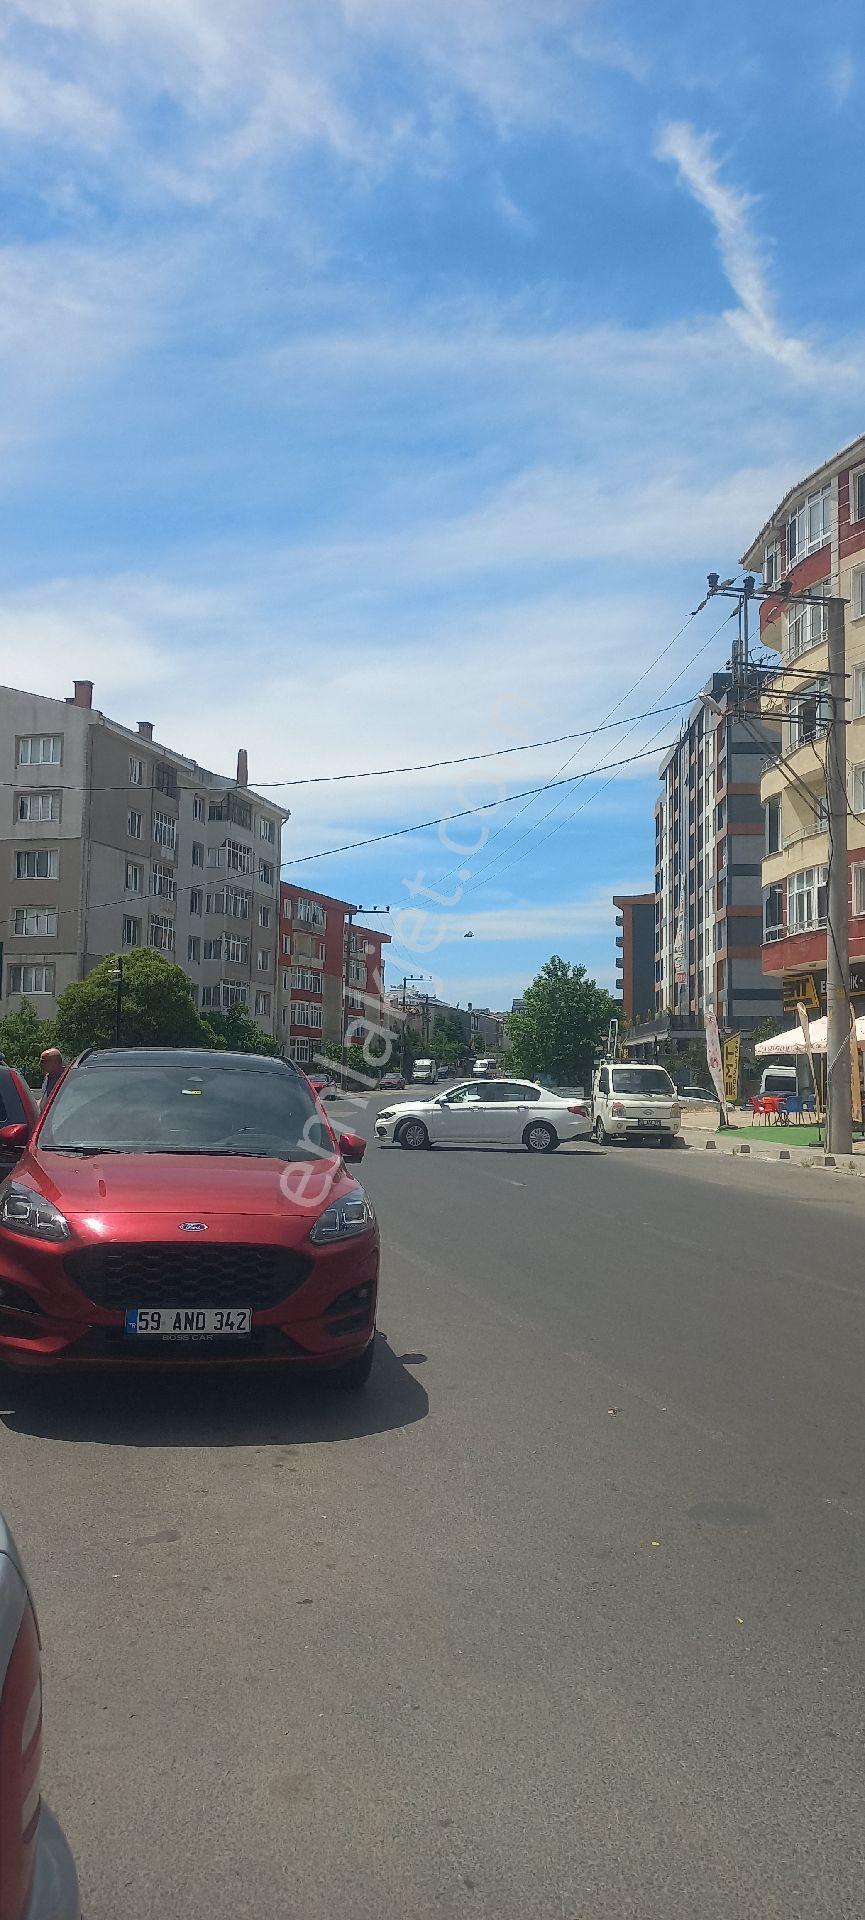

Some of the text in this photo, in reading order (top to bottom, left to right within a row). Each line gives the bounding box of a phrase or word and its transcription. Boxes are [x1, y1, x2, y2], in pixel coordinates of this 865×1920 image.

[726, 1046, 734, 1096] EMT
[138, 1311, 247, 1331] 59 AND 342
